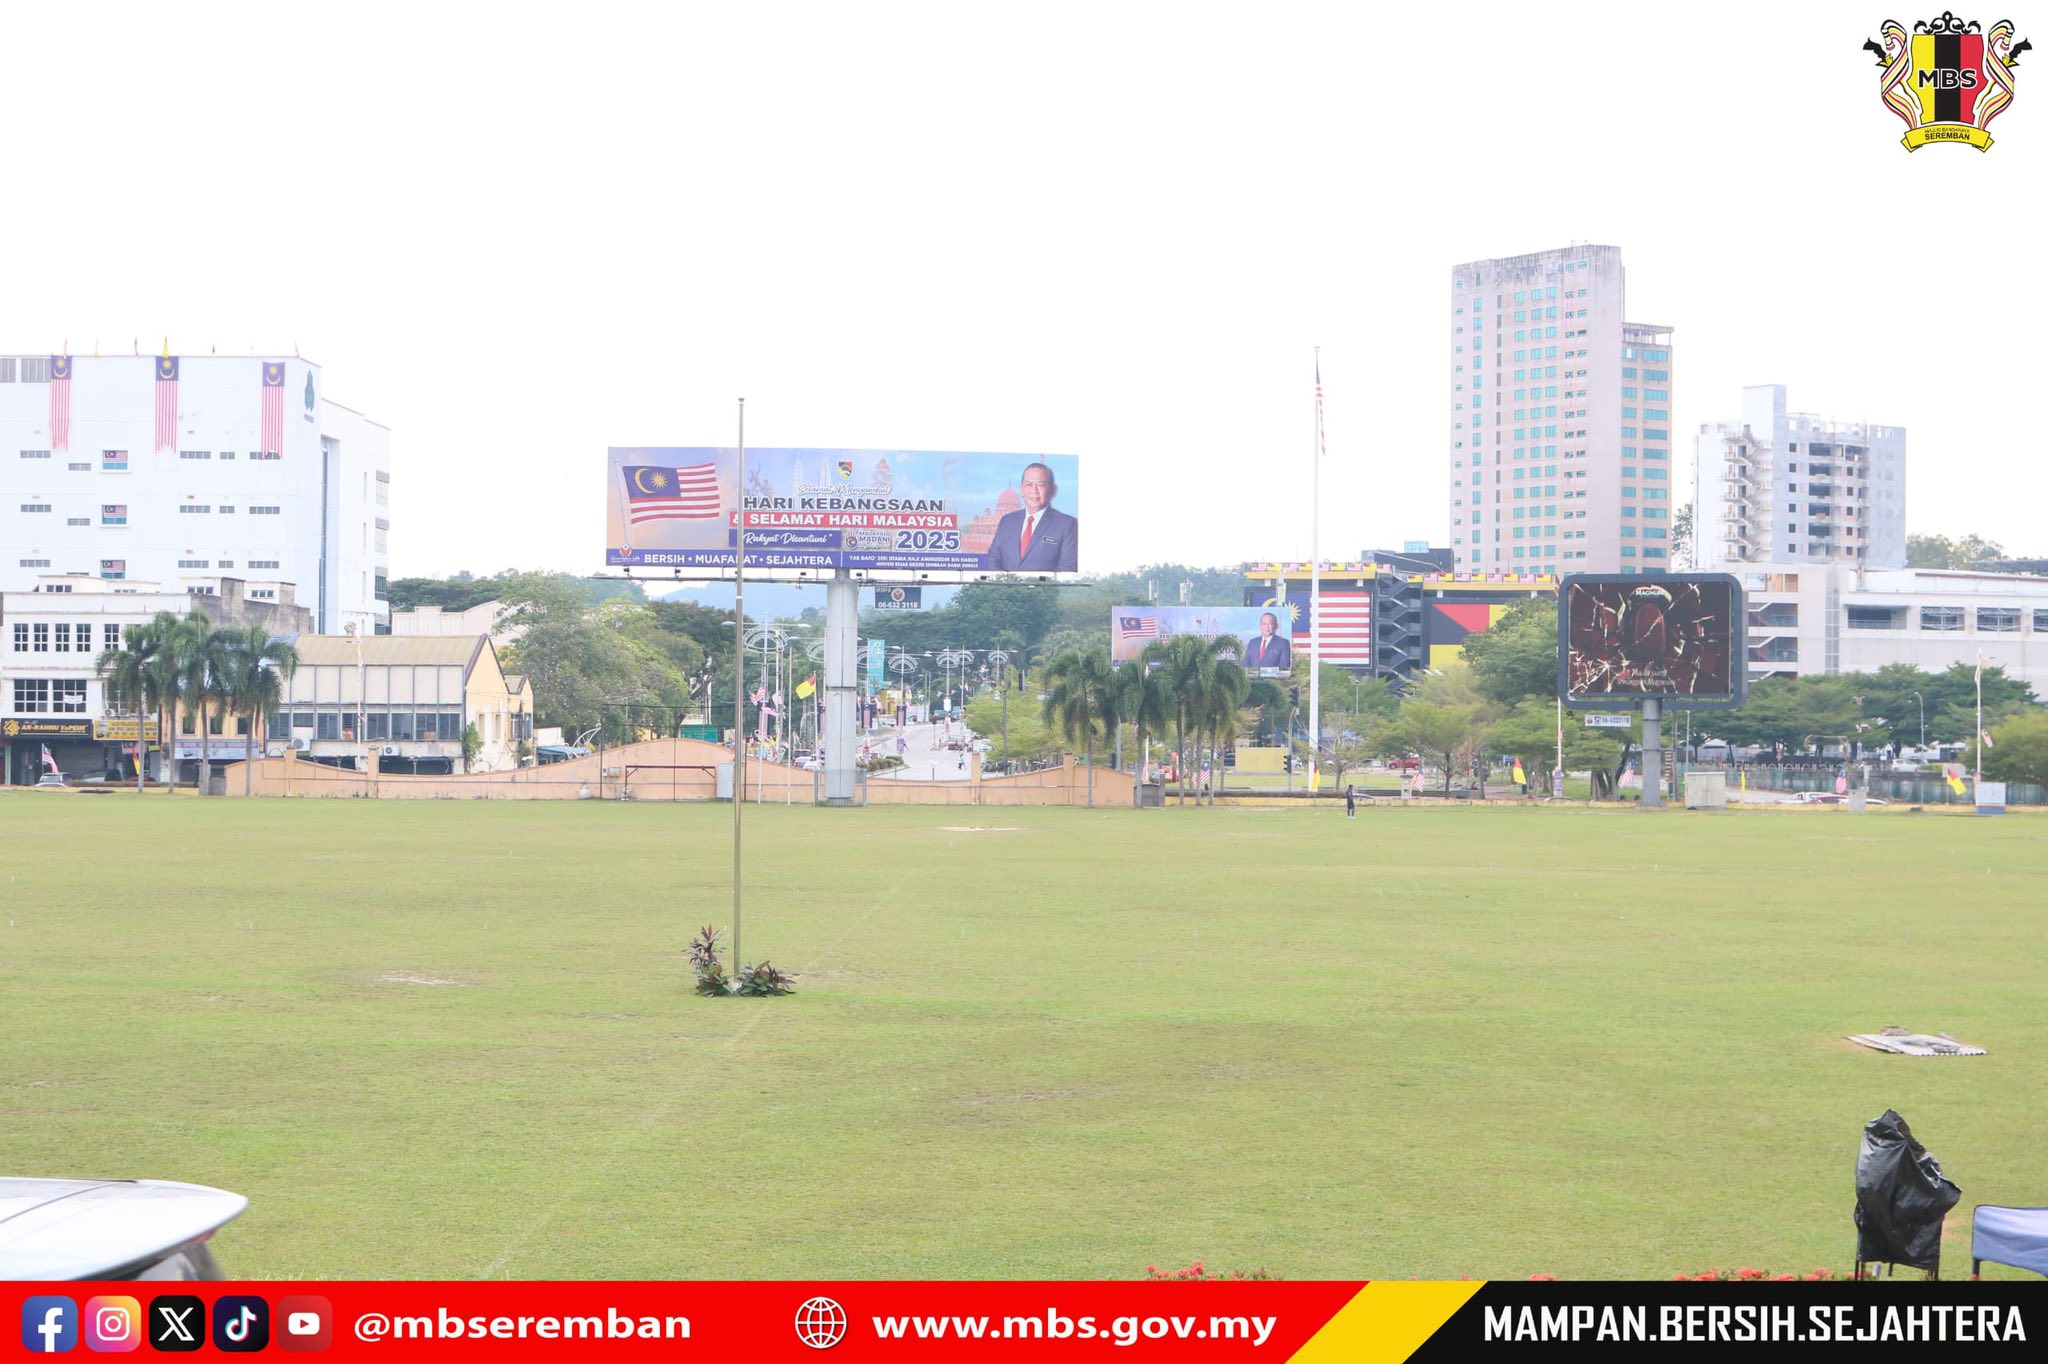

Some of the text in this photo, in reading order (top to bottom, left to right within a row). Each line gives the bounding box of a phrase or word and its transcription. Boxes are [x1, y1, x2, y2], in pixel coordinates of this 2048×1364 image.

[743, 496, 944, 512] HARI KEBANGSAAN
[750, 513, 824, 526] SELAMAT
[829, 514, 868, 527] HARI
[873, 515, 953, 528] MALAYSIA
[896, 530, 960, 550] 2025
[644, 554, 685, 564] BERSIH
[766, 556, 833, 566] SEJAHTERA
